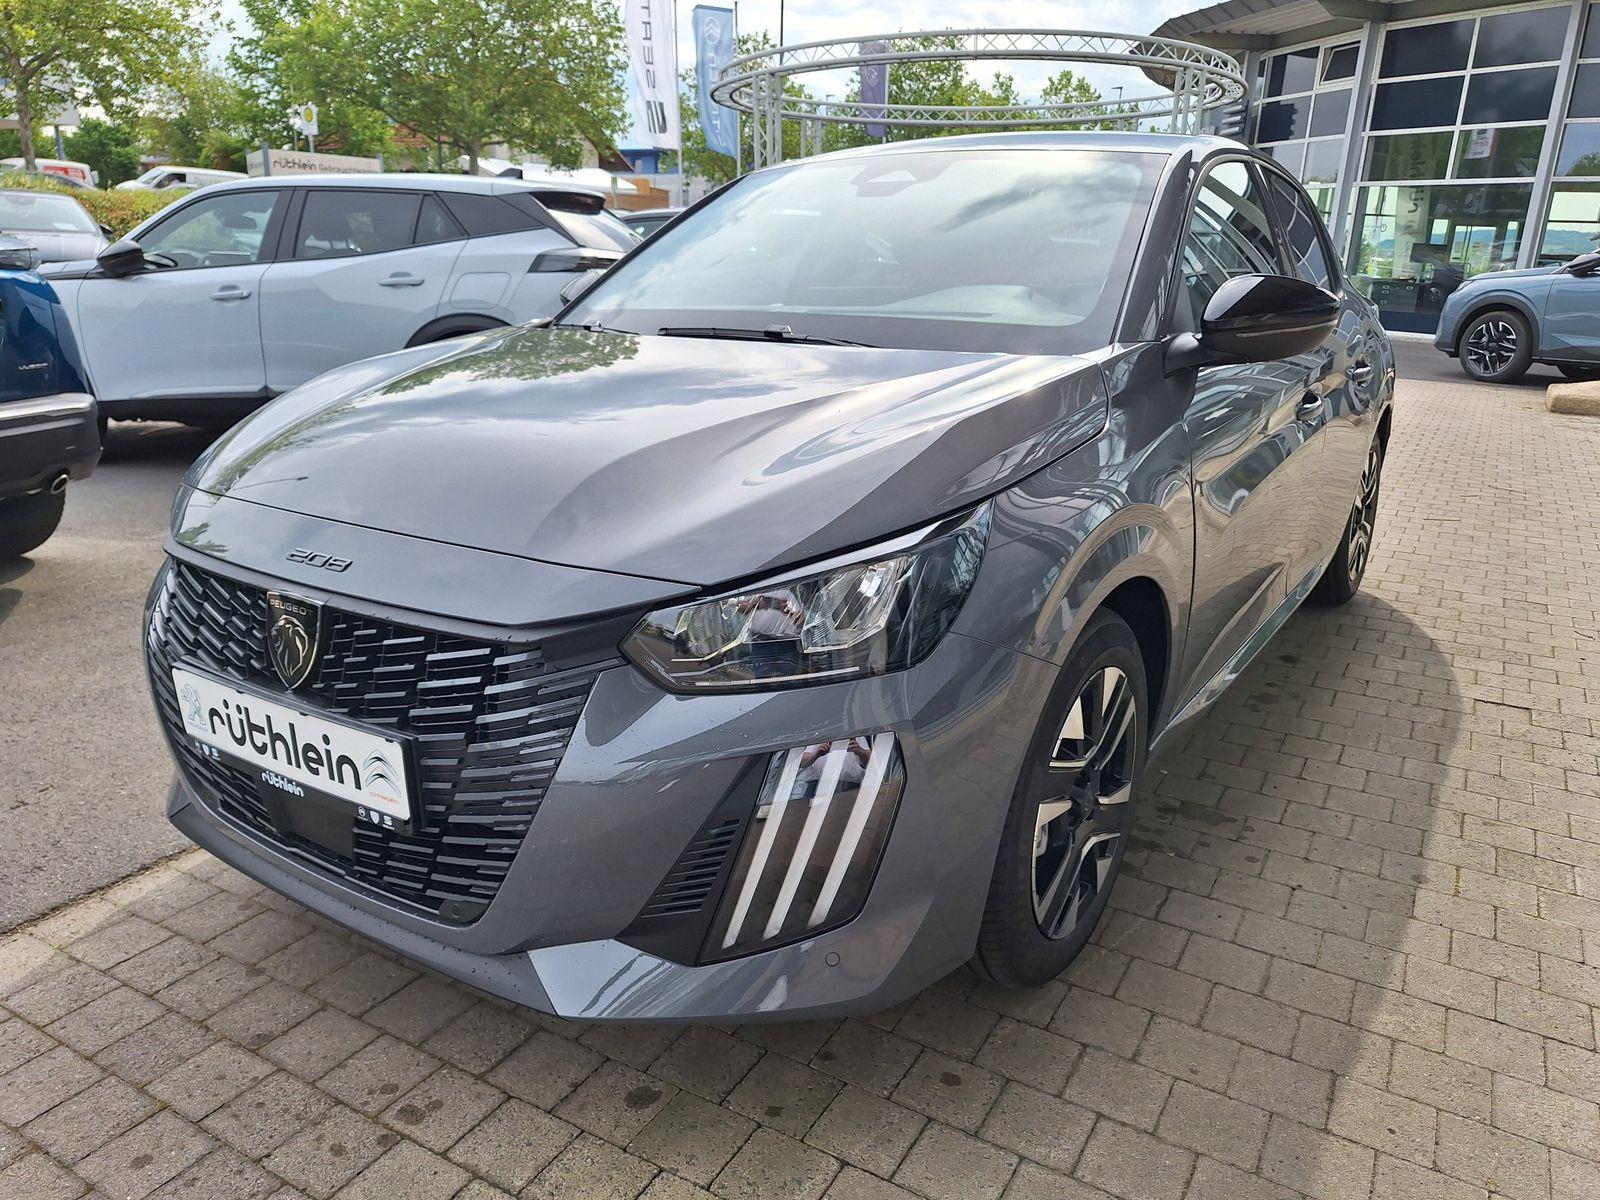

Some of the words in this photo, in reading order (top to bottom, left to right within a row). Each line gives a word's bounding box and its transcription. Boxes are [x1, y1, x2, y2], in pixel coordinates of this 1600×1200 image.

[273, 157, 317, 171] rüthlein
[286, 547, 353, 573] 208
[269, 599, 314, 616] PEUGEOT
[208, 699, 361, 790] rüthlein
[261, 770, 304, 798] rüthlein
